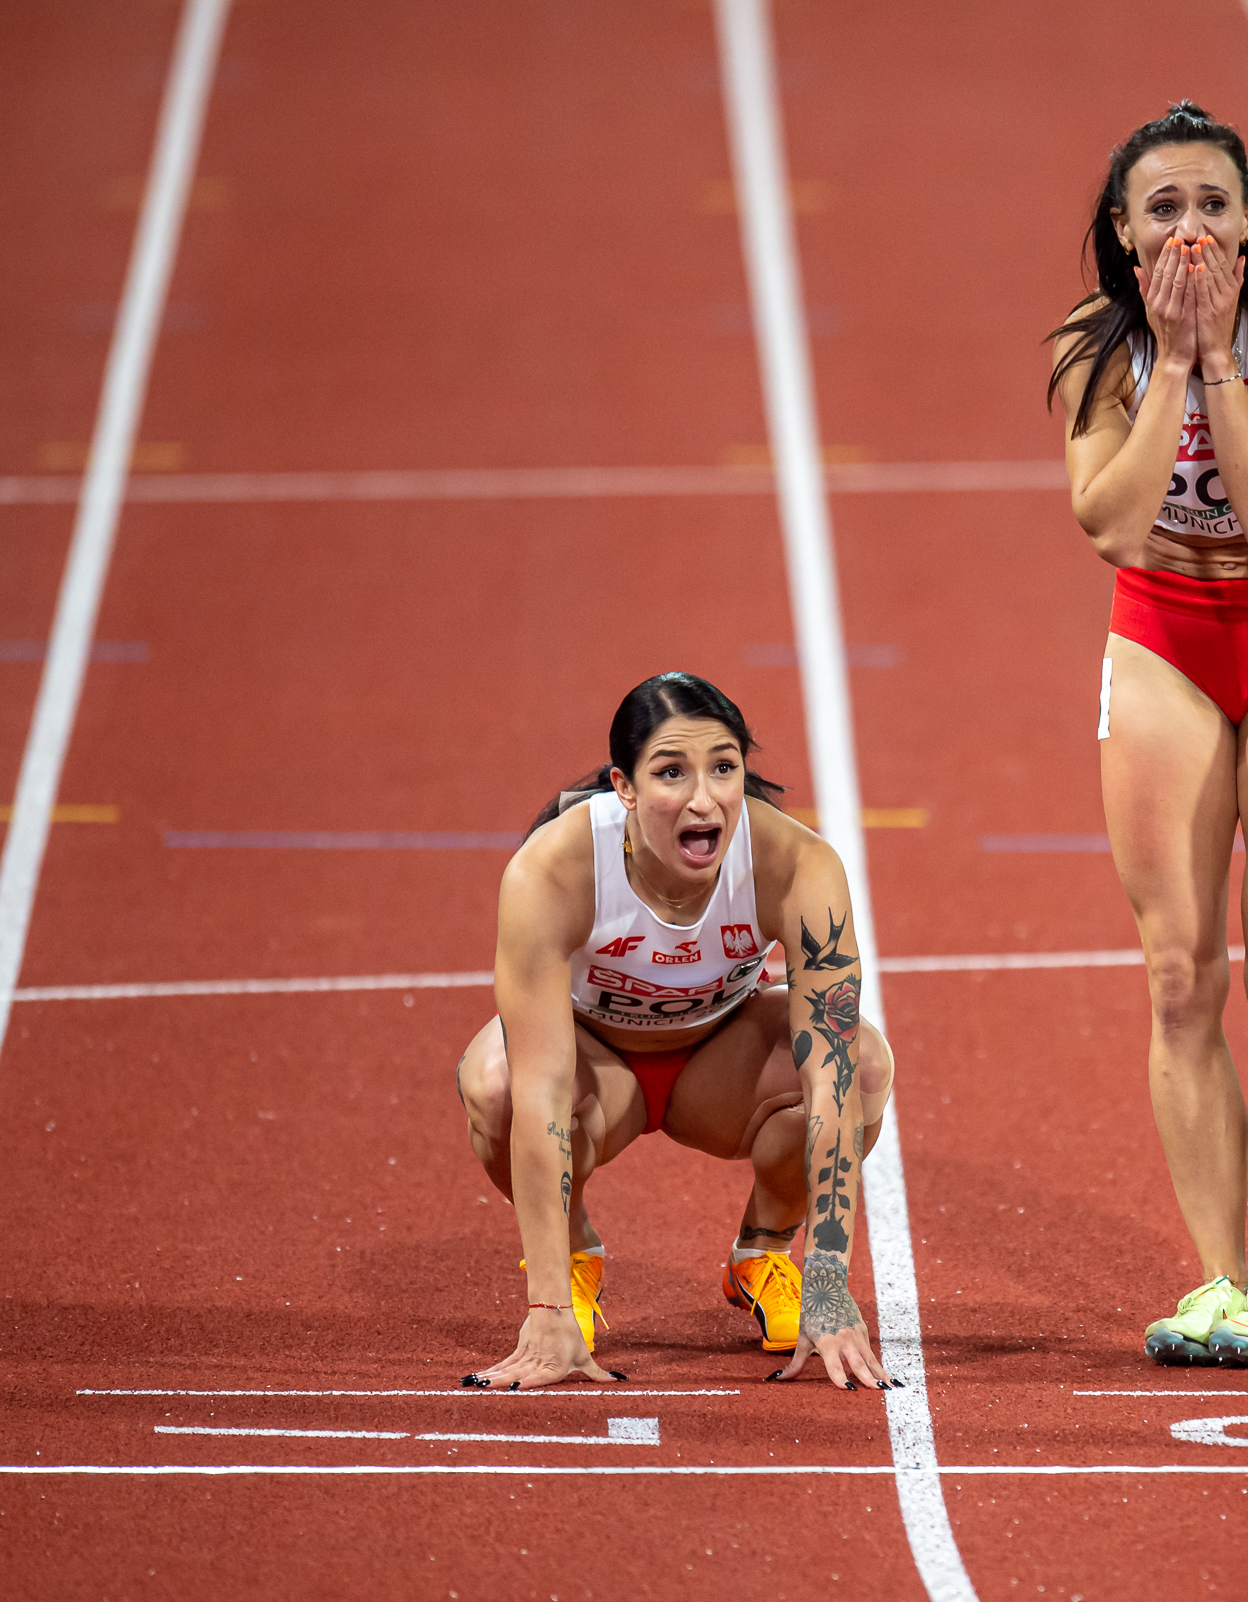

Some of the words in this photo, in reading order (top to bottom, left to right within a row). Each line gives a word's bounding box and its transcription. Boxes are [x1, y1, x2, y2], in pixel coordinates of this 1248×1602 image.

[1178, 428, 1215, 456] PA
[1166, 467, 1230, 508] PO
[655, 952, 699, 964] ORLEN
[592, 966, 721, 998] SPAR
[598, 984, 748, 1016] POL
[588, 1008, 686, 1027] MUNICH
